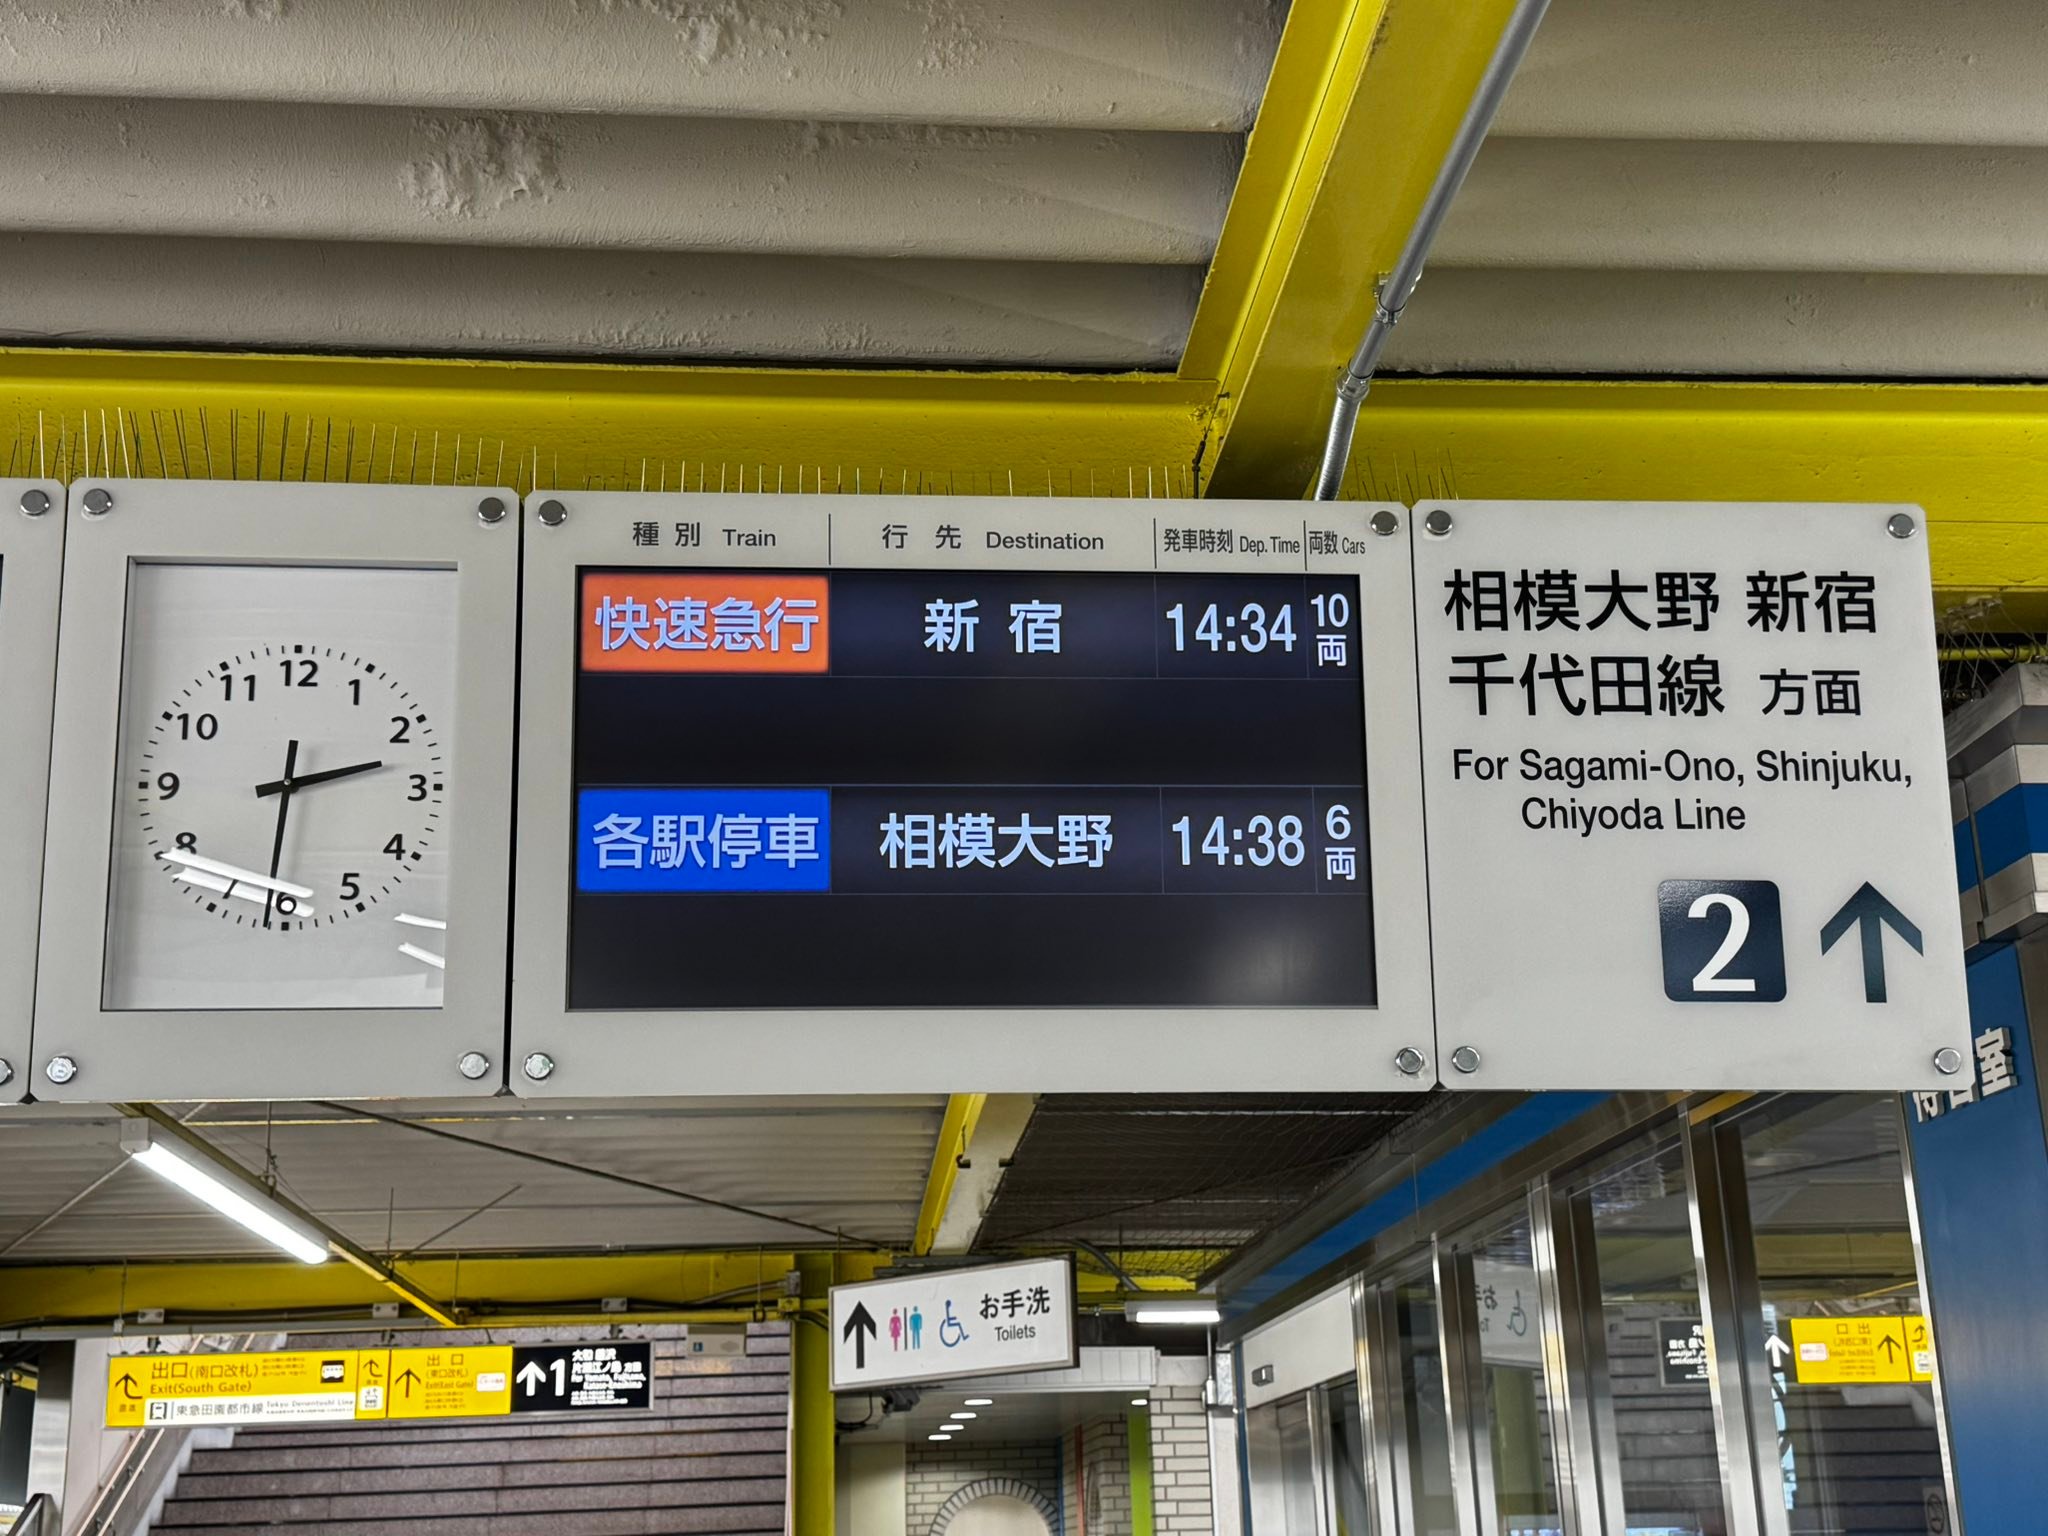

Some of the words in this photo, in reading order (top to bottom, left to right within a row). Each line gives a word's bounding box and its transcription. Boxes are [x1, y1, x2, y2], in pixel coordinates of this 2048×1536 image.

[633, 521, 701, 547] 種別
[722, 528, 777, 547] Train
[986, 531, 1104, 551] Destination
[1163, 528, 1234, 554] 発車時刻
[1240, 536, 1268, 556] Dep.
[1270, 536, 1300, 554] Time
[1308, 530, 1339, 555] 両数
[1341, 537, 1366, 555] Cars
[1310, 592, 1350, 628] 10
[1443, 568, 1720, 632] 相模大野
[1746, 570, 1878, 634] 新宿
[594, 595, 819, 653] 快速急行
[923, 598, 1063, 654] 新宿
[1165, 603, 1297, 653] 14:34
[1316, 633, 1348, 668] 両
[279, 659, 319, 688] 12
[1448, 653, 1726, 717] 千代田線
[1759, 668, 1862, 717] 方面
[220, 674, 257, 703] 11
[348, 679, 361, 706] 1
[177, 713, 219, 741] 10
[389, 717, 412, 744] 2
[1452, 748, 1510, 781] For
[1519, 748, 1745, 789] Sagami-Ono,
[1755, 749, 1913, 791] Shinjuku,
[156, 772, 181, 800] 9
[406, 774, 429, 803] 3
[1325, 804, 1352, 840] 6
[1521, 796, 1664, 838] Chiyoda
[1675, 798, 1747, 831] Line
[382, 833, 407, 862] 4
[592, 812, 820, 869] 各駅停車
[878, 812, 1113, 869] 相模大野
[1171, 815, 1306, 867] 14:38
[1324, 846, 1357, 881] 両
[339, 872, 361, 901] 5
[1687, 893, 1757, 993] 2
[979, 1285, 1051, 1321] お手洗
[994, 1324, 1037, 1342] Toilets
[150, 1381, 214, 1395] Exit(South
[218, 1381, 253, 1394] Gate)
[549, 1358, 566, 1397] 1
